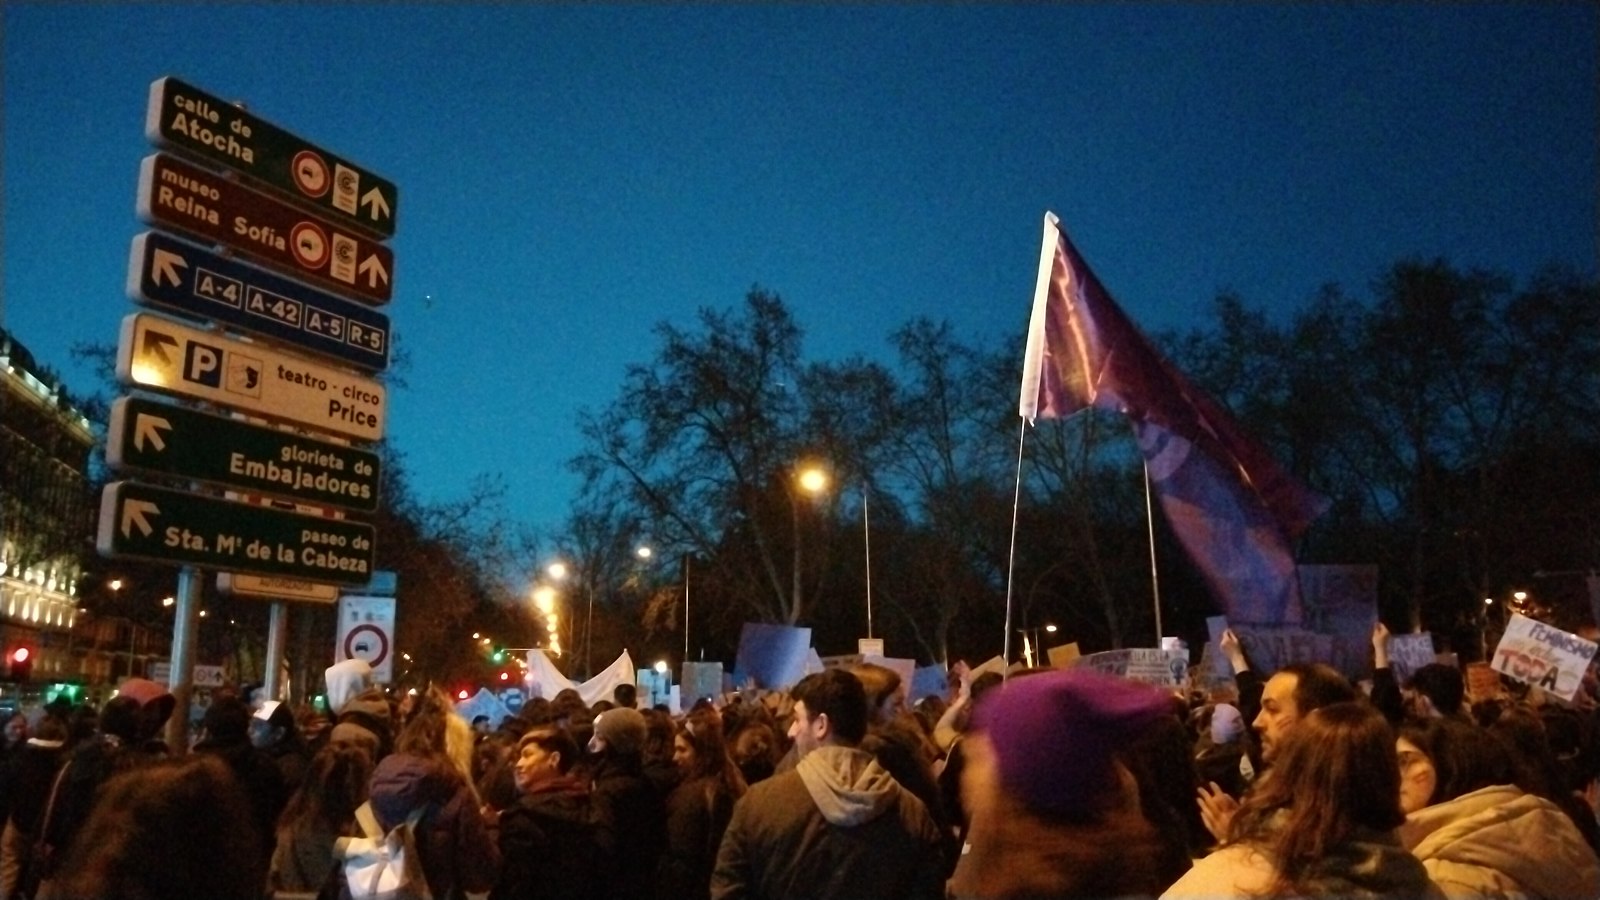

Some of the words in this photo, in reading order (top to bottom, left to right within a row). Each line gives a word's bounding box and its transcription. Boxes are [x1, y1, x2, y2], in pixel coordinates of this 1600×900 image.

[174, 94, 219, 124] calle
[231, 119, 252, 138] de
[171, 113, 254, 163] Atocha
[161, 168, 220, 201] museo
[158, 186, 219, 225] Reina
[200, 276, 238, 303] A-4
[250, 293, 298, 323] A-42
[308, 313, 341, 336] A-5
[351, 326, 381, 349] R-5
[190, 345, 218, 380] P
[277, 364, 327, 391] teatro
[342, 385, 380, 406] circo
[328, 400, 378, 428] Price
[230, 452, 371, 499] Embajadores
[281, 445, 344, 471] glorieta
[354, 458, 373, 477] de
[164, 526, 210, 552] Sta.
[246, 538, 271, 561] de
[277, 543, 295, 564] la
[301, 548, 368, 574] Cabeza
[302, 529, 347, 548] paseo
[352, 534, 370, 551] de
[1528, 622, 1596, 660] FEMINISMO
